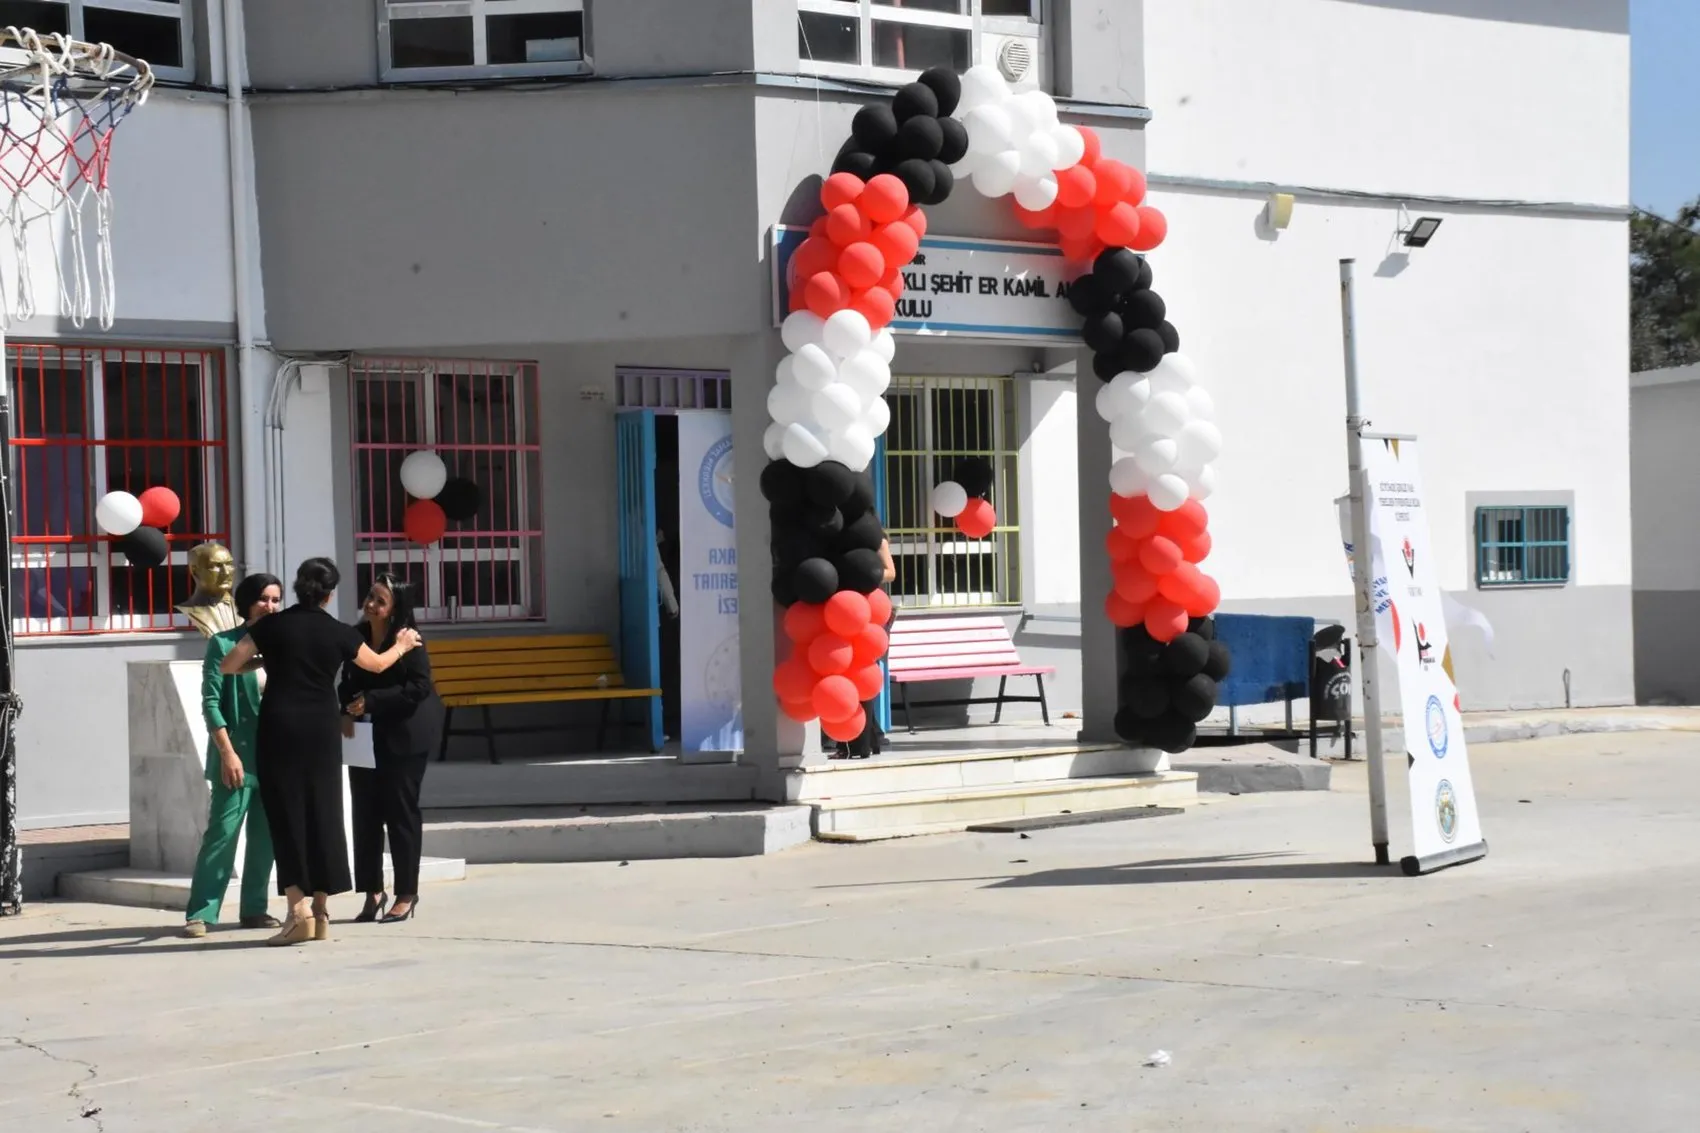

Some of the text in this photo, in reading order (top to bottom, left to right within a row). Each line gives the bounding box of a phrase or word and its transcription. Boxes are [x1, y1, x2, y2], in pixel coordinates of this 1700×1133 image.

[931, 271, 972, 294] ŞEHİT
[979, 277, 998, 295] ER
[1004, 276, 1050, 298] KAMİL
